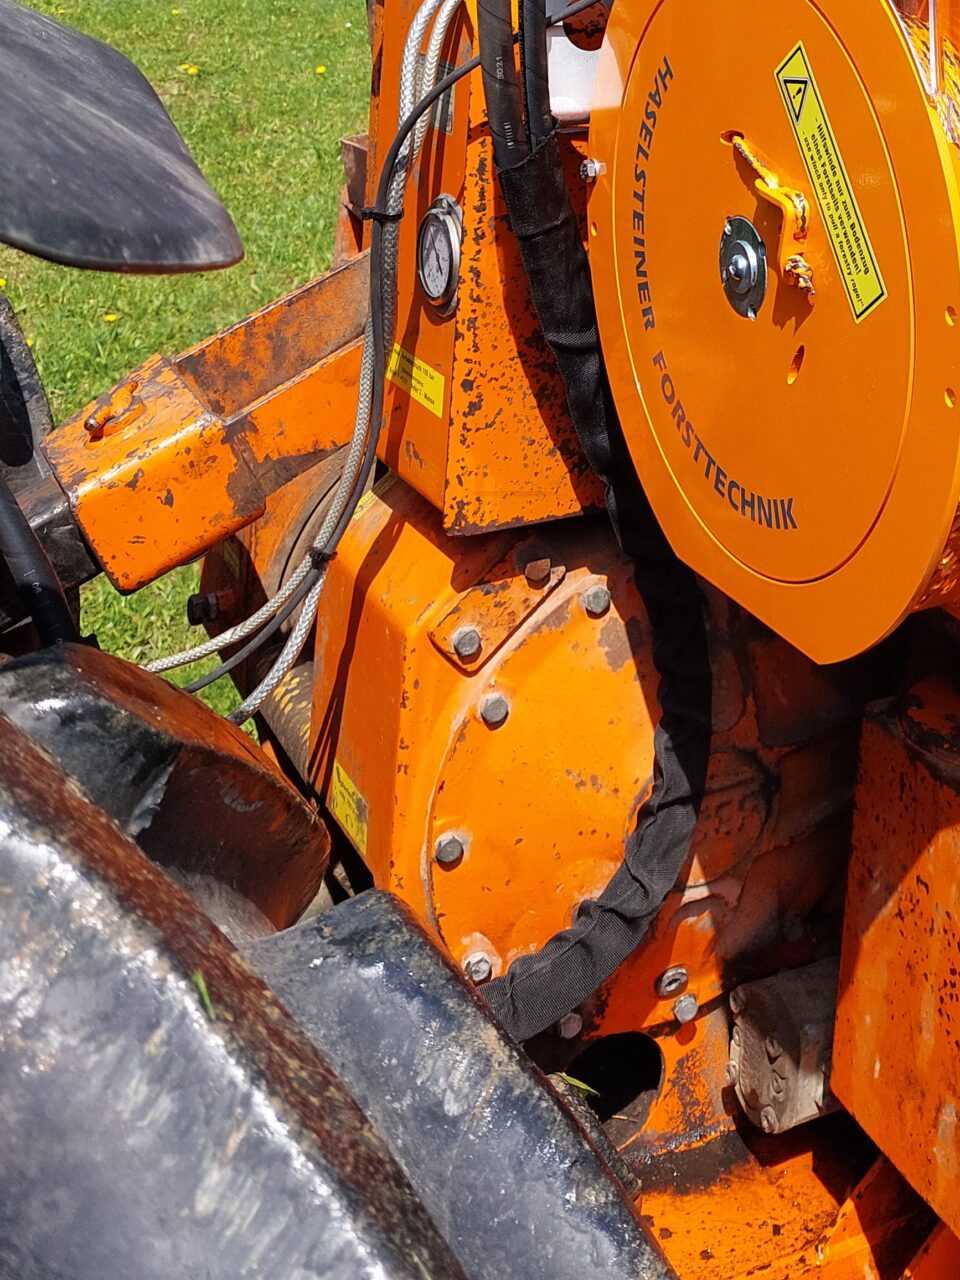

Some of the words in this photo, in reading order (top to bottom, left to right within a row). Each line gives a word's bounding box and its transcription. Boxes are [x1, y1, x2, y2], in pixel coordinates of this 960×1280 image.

[629, 56, 675, 333] HASELSTEINER
[803, 136, 811, 152] use
[809, 153, 821, 180] winch
[818, 181, 827, 199] only
[828, 213, 838, 230] pull
[837, 240, 852, 275] forestry
[810, 133, 822, 161] eines
[820, 161, 839, 212] Forstseils
[837, 213, 861, 275] verwenden!
[816, 123, 837, 177] Hilfswinde
[835, 179, 843, 196] nur
[841, 199, 851, 221] zum
[849, 221, 869, 275] Bodenzug
[652, 349, 798, 530] FORSTTECHNIK
